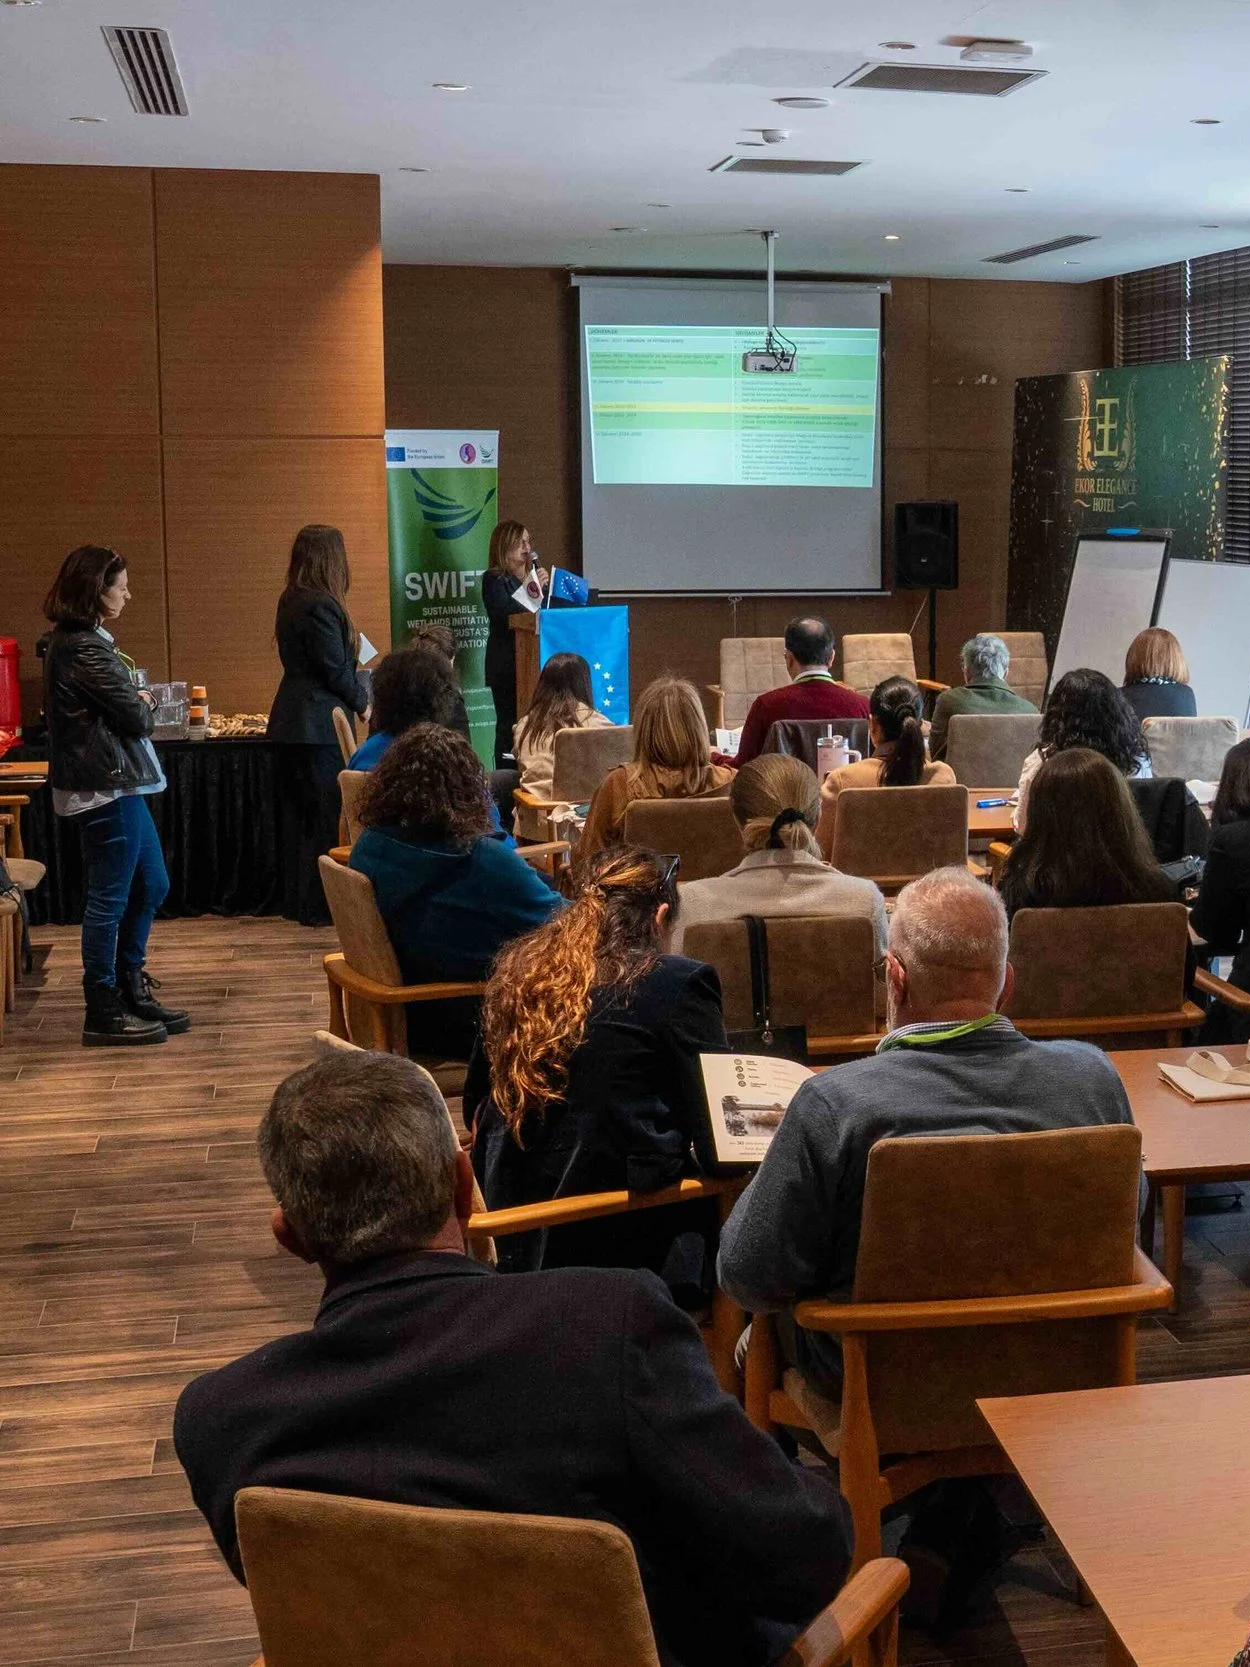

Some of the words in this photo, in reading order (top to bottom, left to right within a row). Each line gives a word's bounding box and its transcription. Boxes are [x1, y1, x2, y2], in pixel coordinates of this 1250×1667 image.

[1074, 479, 1095, 493] EKOR
[1096, 479, 1137, 494] ELEGANCE
[1092, 497, 1116, 512] HOTEL
[422, 605, 478, 616] SUSTAINABLE
[452, 616, 489, 627] INITIATIV
